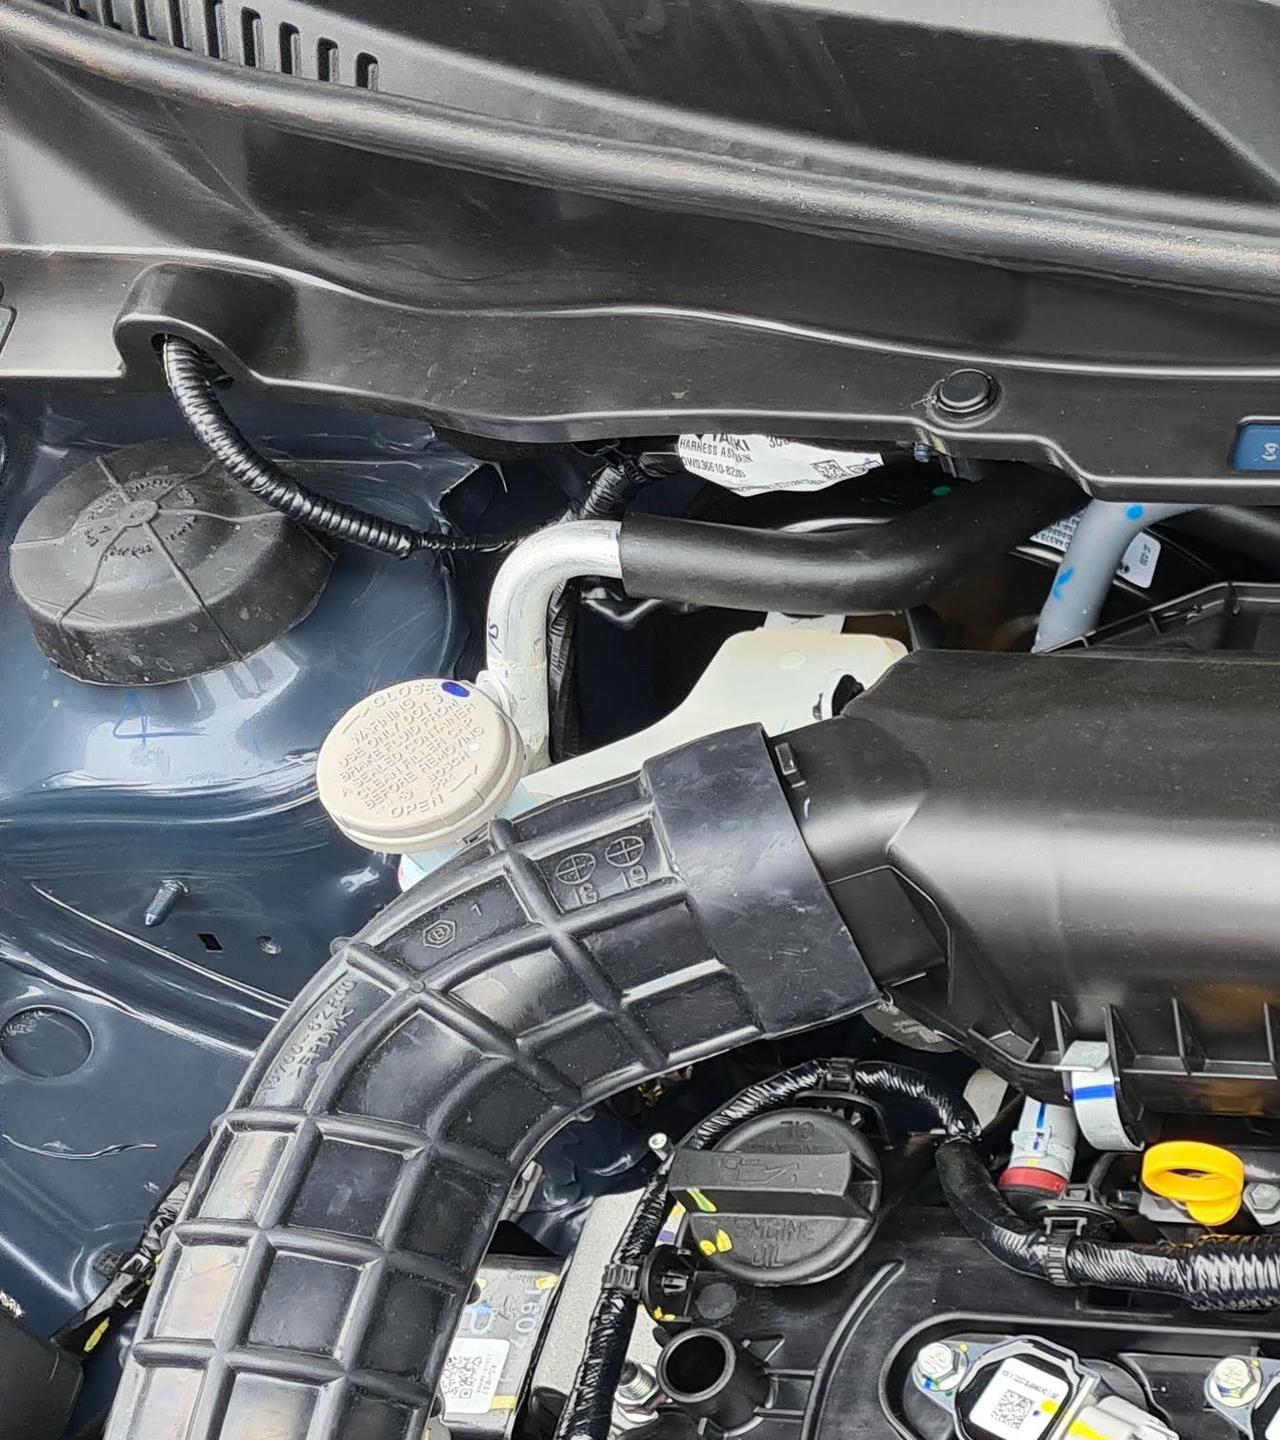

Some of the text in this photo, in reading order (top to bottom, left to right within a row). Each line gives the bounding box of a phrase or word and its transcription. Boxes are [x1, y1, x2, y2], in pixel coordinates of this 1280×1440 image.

[680, 439, 718, 455] HARNESS
[374, 683, 438, 707] CLOSE
[339, 746, 366, 766] USE
[368, 722, 399, 749] ONLY
[403, 702, 431, 724] DOT
[340, 699, 460, 781] BRAKE FLUID FROM
[352, 698, 415, 744] WARNING
[405, 703, 476, 751] CONTAINER
[419, 726, 485, 773] REMOVING
[391, 794, 445, 818] OPEN
